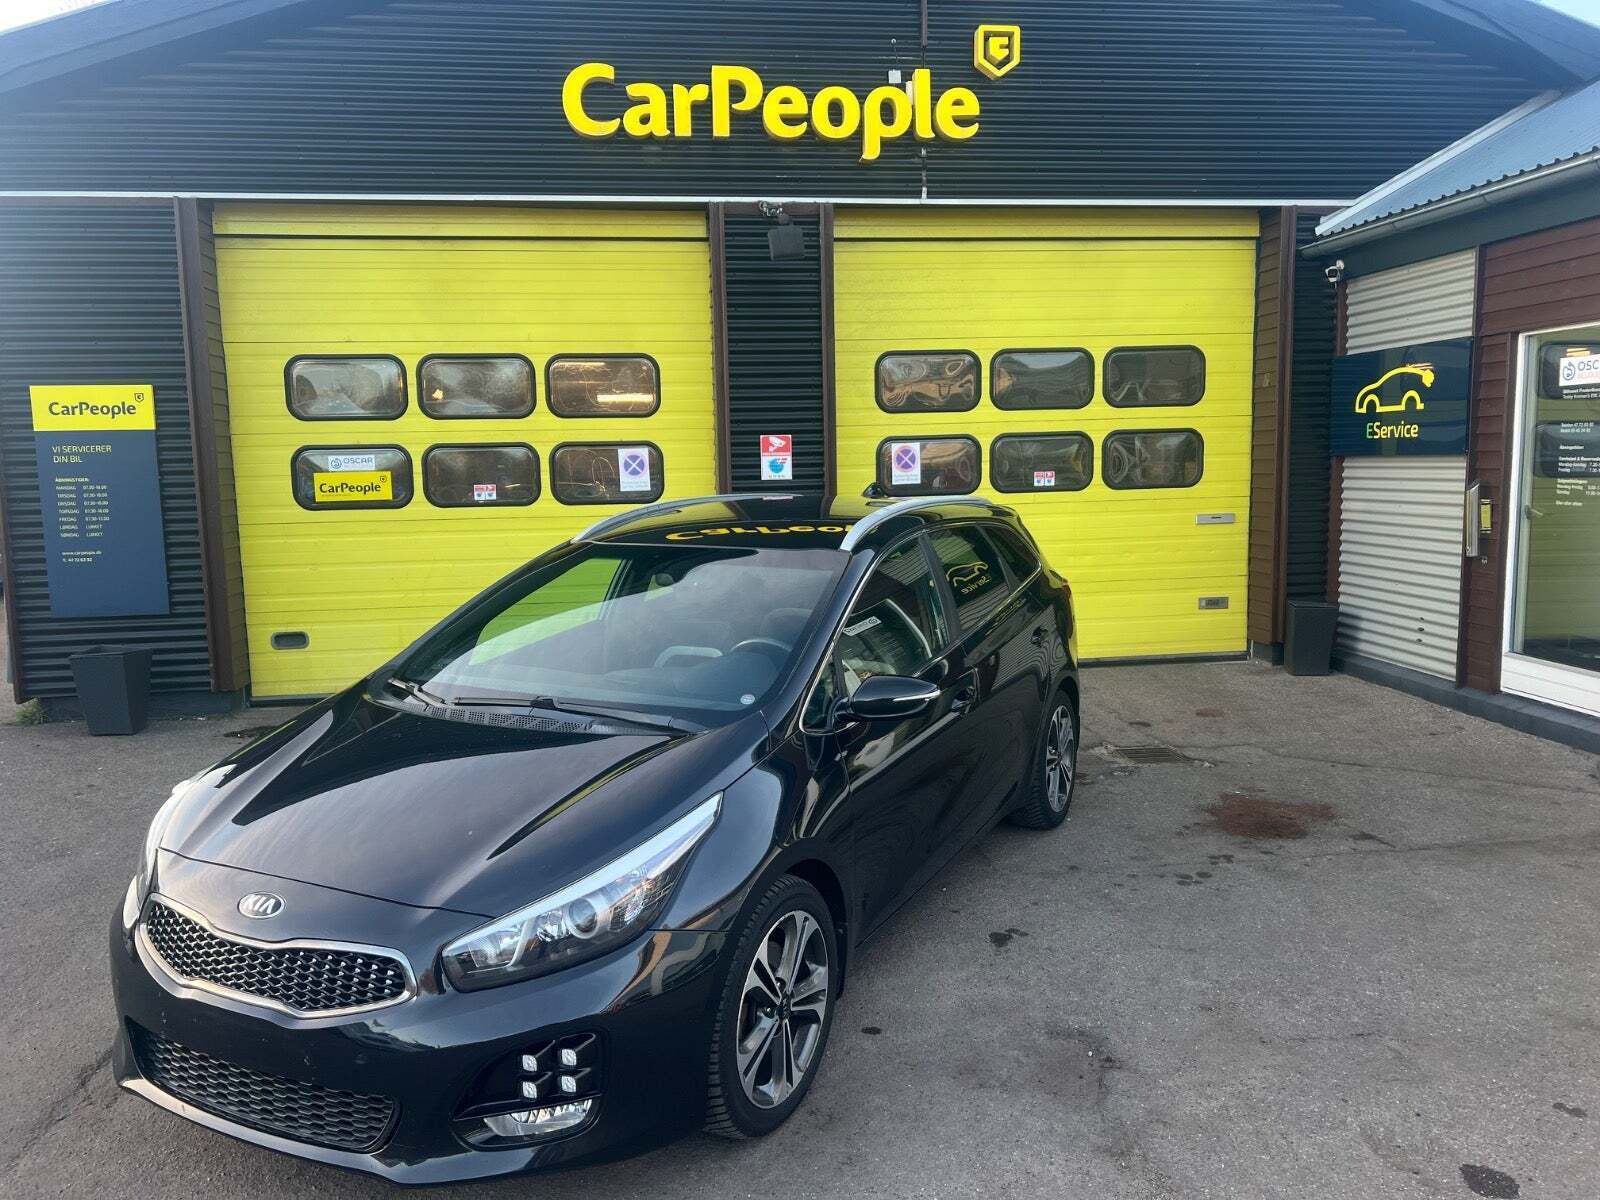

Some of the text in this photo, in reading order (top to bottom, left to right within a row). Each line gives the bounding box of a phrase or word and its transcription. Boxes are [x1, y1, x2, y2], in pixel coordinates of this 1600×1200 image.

[561, 62, 981, 162] CarPeople
[48, 401, 137, 419] CarPeople
[1366, 420, 1419, 439] EService
[62, 445, 112, 453] SERVICERER
[53, 455, 83, 463] DIN BIL
[343, 457, 373, 465] OSCAR
[319, 482, 381, 495] CarPeople
[242, 895, 276, 914] KIA
